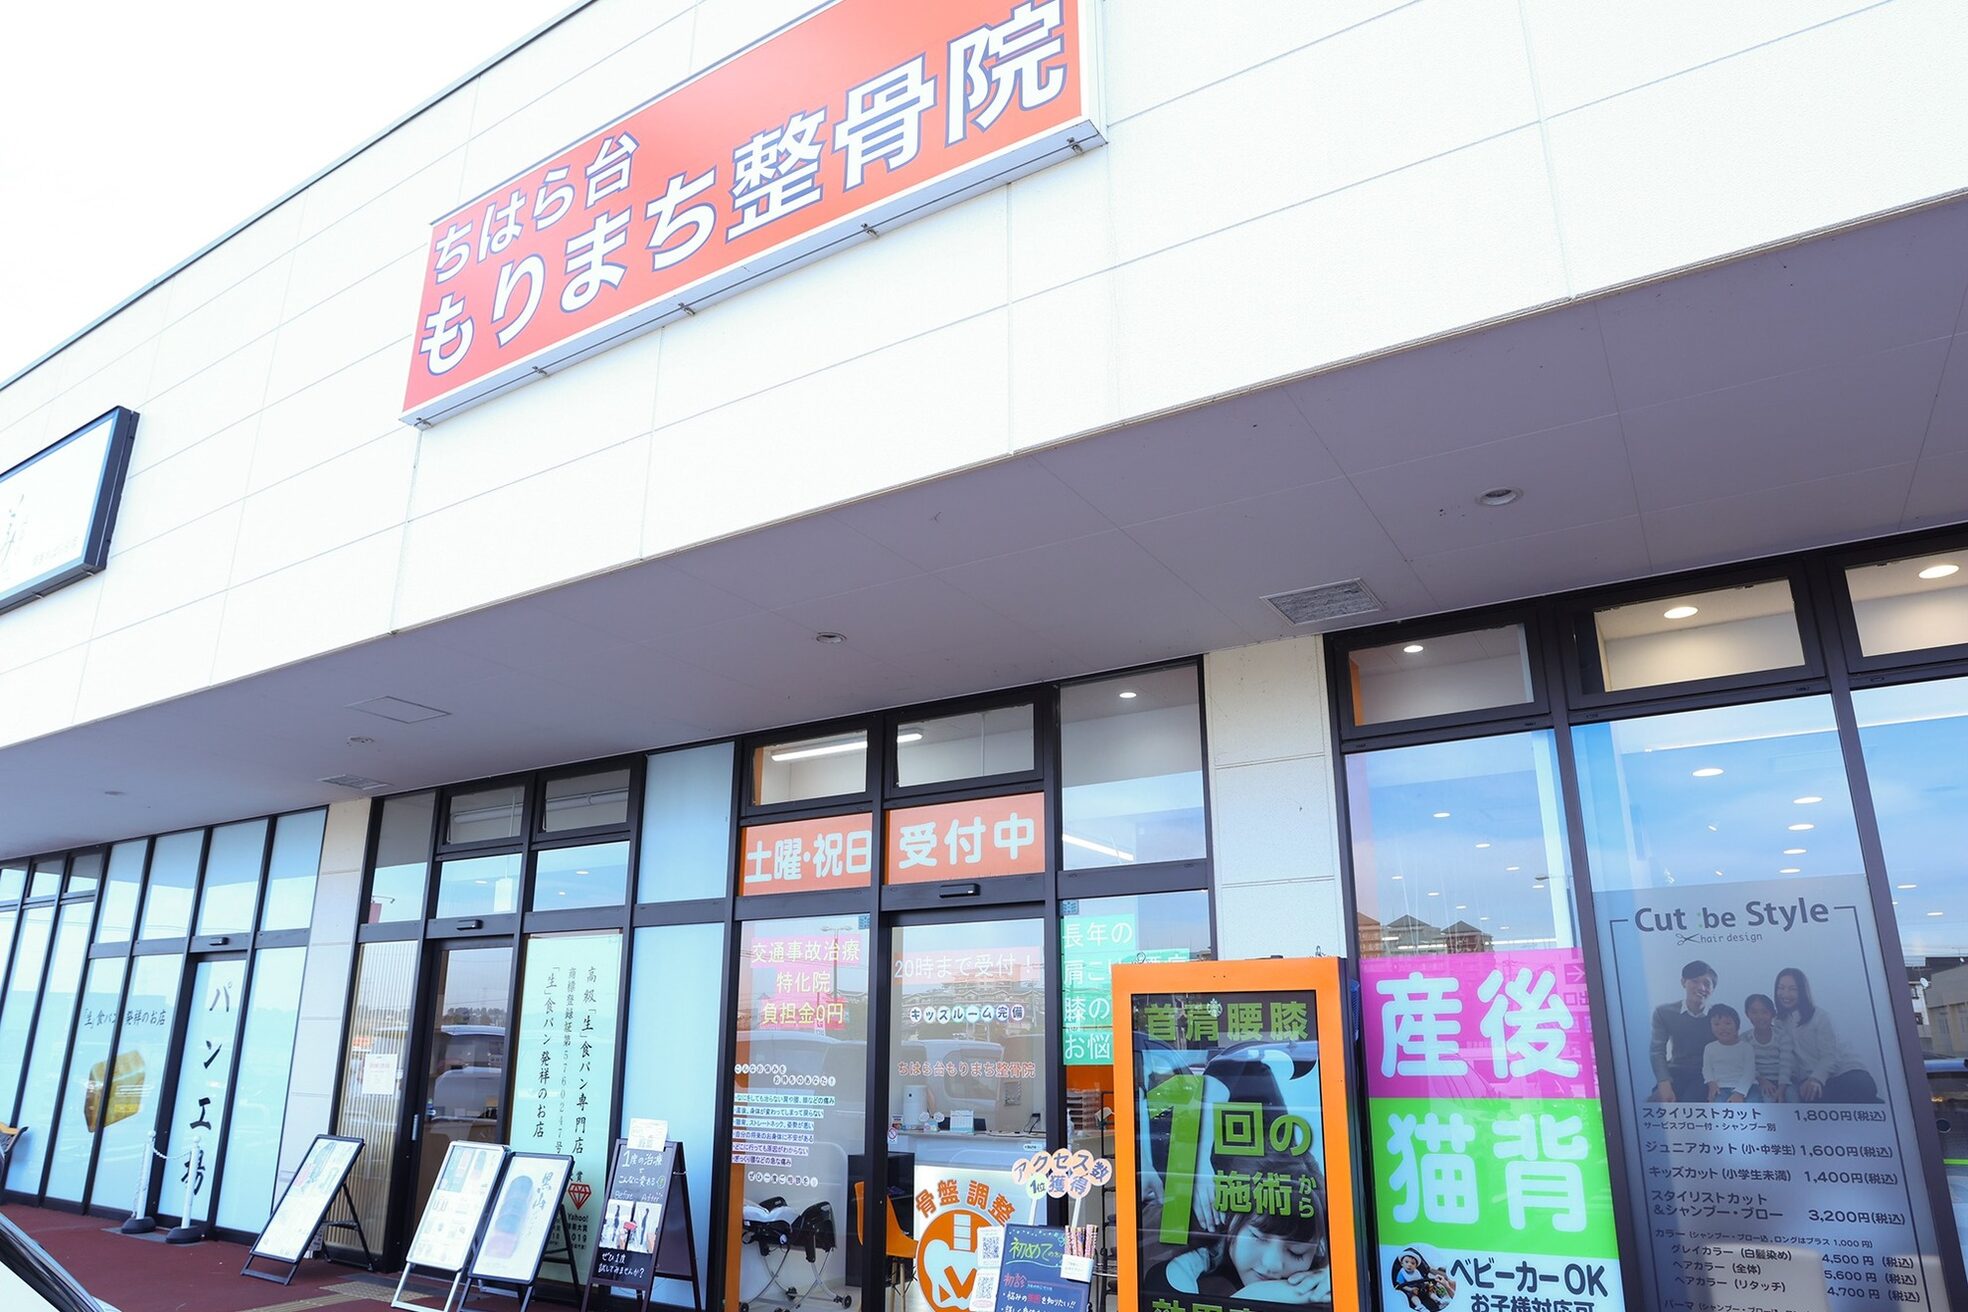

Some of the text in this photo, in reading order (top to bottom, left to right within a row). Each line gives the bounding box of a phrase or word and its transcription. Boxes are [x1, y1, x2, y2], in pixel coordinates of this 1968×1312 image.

[418, 0, 1068, 377] もりまち整骨院
[432, 131, 641, 284] ちはら台
[744, 812, 1035, 884] 土曜・祝日 受付中
[1635, 908, 1688, 932] Cut
[1745, 897, 1829, 932] Style
[1063, 922, 1133, 947] 長年の
[1700, 932, 1763, 943] hair design
[752, 939, 861, 963] 交通事故治療
[776, 971, 831, 993] 特化院
[762, 1001, 844, 1024] 負担金0円
[910, 1005, 1025, 1022] キッズルーム完備
[1145, 1001, 1310, 1042] 首肩腰膝
[1376, 967, 1579, 1080] 産後
[532, 967, 560, 1138] 「生」食パン発祥のお店
[572, 965, 599, 1155] 高級「生」食パン専門店
[898, 1061, 1037, 1078] ちはら台もりまち整骨院
[1642, 1107, 1886, 1122] スタイリストカット 1,800円(税込)
[1645, 1141, 1737, 1154] ジュニアカット
[1800, 1145, 1893, 1158] 1,600円(税込)
[1014, 1152, 1110, 1183] アクセス数
[1387, 1112, 1588, 1231] 猫背
[1649, 1166, 1718, 1178] キッズカット
[1804, 1171, 1898, 1185] 1,400円(税込)
[915, 1179, 1016, 1228] 骨盤調整
[1651, 1190, 1767, 1205] スタイリストカット
[1654, 1204, 1906, 1226] &シャンプー・ブロー 3,200円(税込)
[571, 1232, 588, 1243] 019
[1655, 1229, 1685, 1237] カラー
[1671, 1244, 1733, 1256] グレイカラー
[1882, 1256, 1914, 1269] (税込)
[1450, 1257, 1608, 1297] ベビーカーOK
[1673, 1261, 1725, 1271] ヘアカラー
[1732, 1263, 1761, 1275] (全体)
[1885, 1273, 1917, 1286] (税込)
[1675, 1276, 1727, 1287] ヘアカラー
[1734, 1279, 1786, 1293] (リタッチ)
[1888, 1290, 1921, 1303] (税込)
